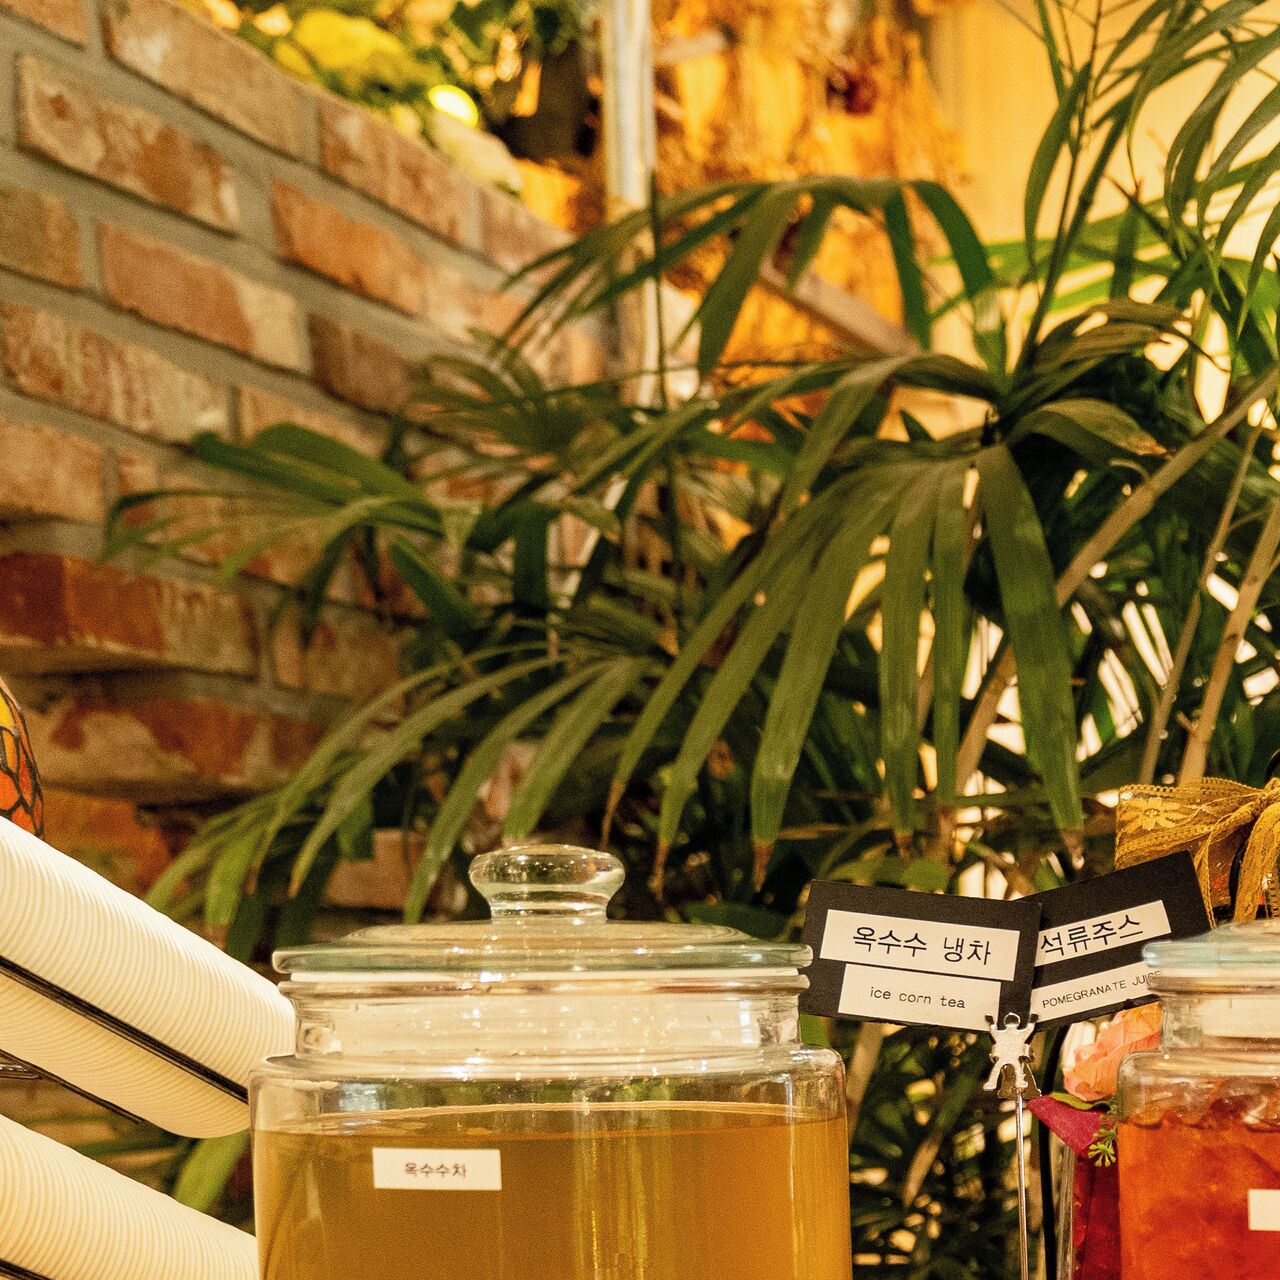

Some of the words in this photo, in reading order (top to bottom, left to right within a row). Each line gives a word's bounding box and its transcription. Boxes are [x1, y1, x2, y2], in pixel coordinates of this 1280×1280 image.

[852, 926, 928, 958] 옥수수
[942, 938, 992, 966] 냉차
[1040, 914, 1145, 958] 석류주스
[869, 985, 892, 1001] ice
[898, 992, 934, 1005] corn
[939, 993, 967, 1009] tea
[1042, 979, 1128, 1009] POMEGRANATE
[404, 1162, 467, 1178] 옥수수차
